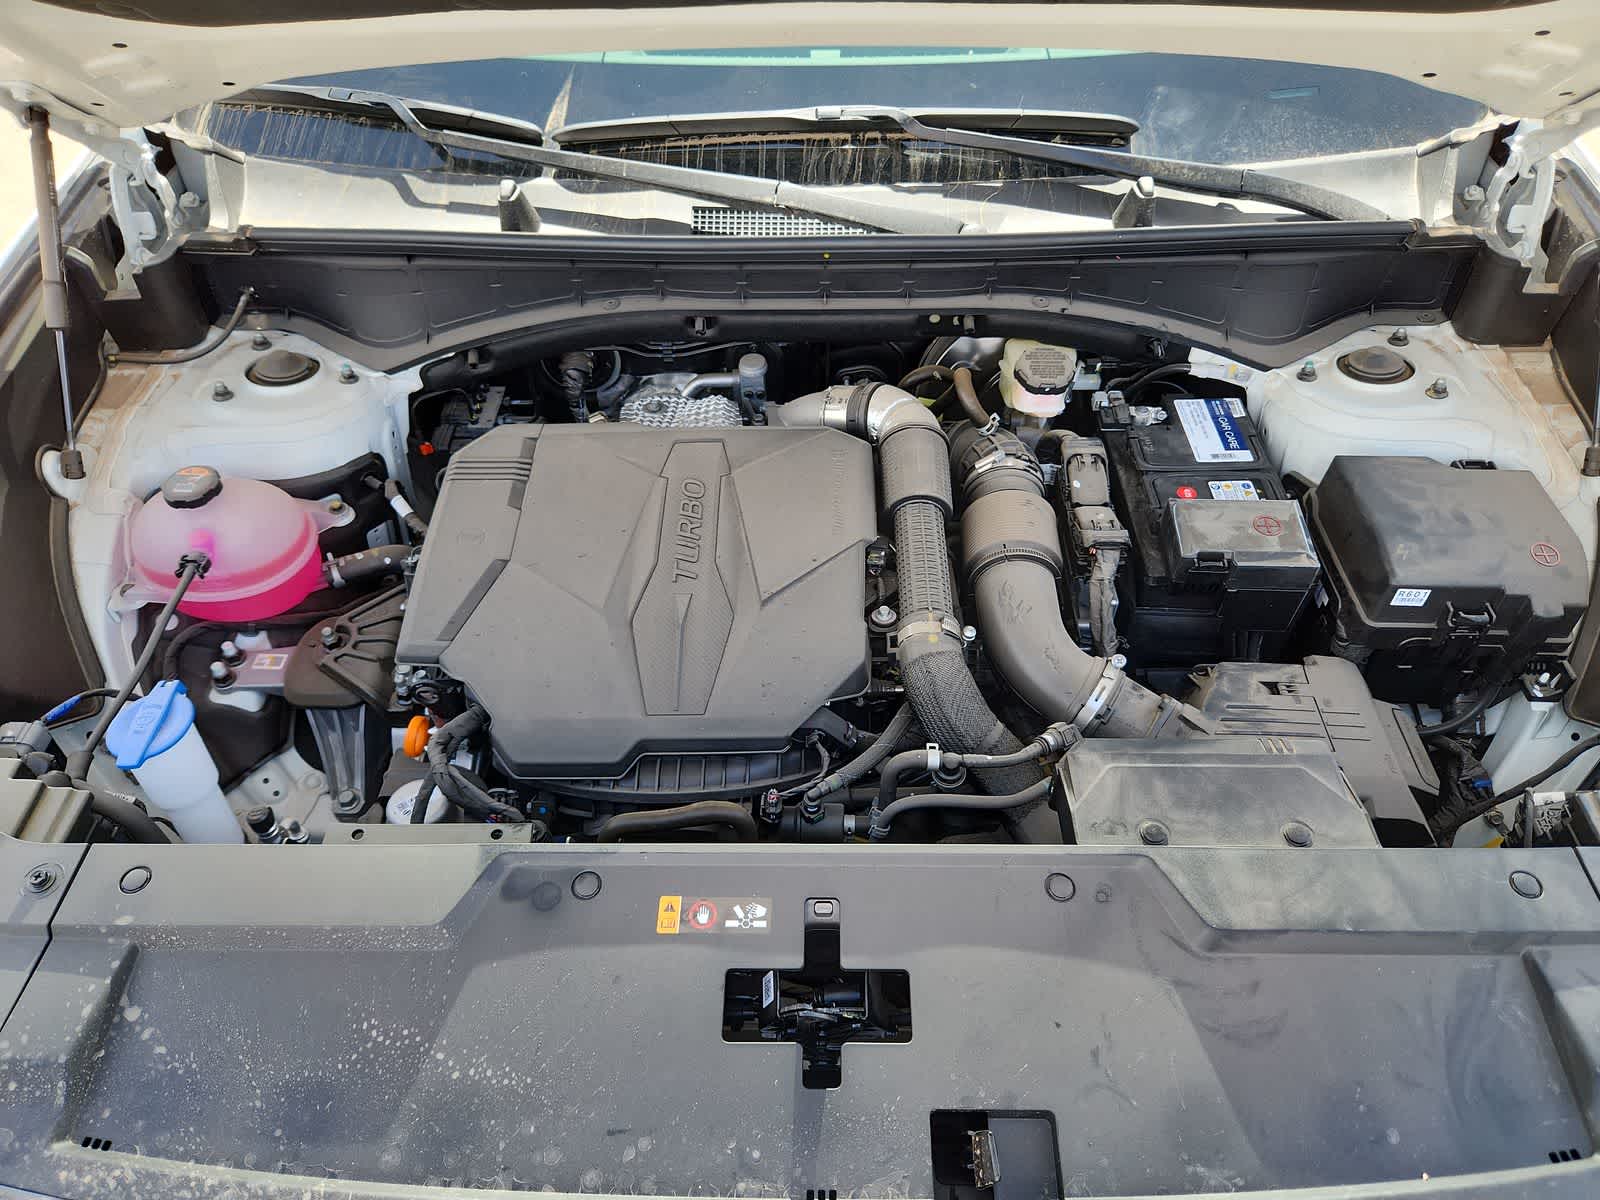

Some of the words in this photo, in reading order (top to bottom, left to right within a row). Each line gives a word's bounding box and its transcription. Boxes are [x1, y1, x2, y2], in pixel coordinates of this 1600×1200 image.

[1218, 417, 1232, 431] CAR
[1224, 431, 1240, 449] CARE
[672, 478, 706, 583] TURBO
